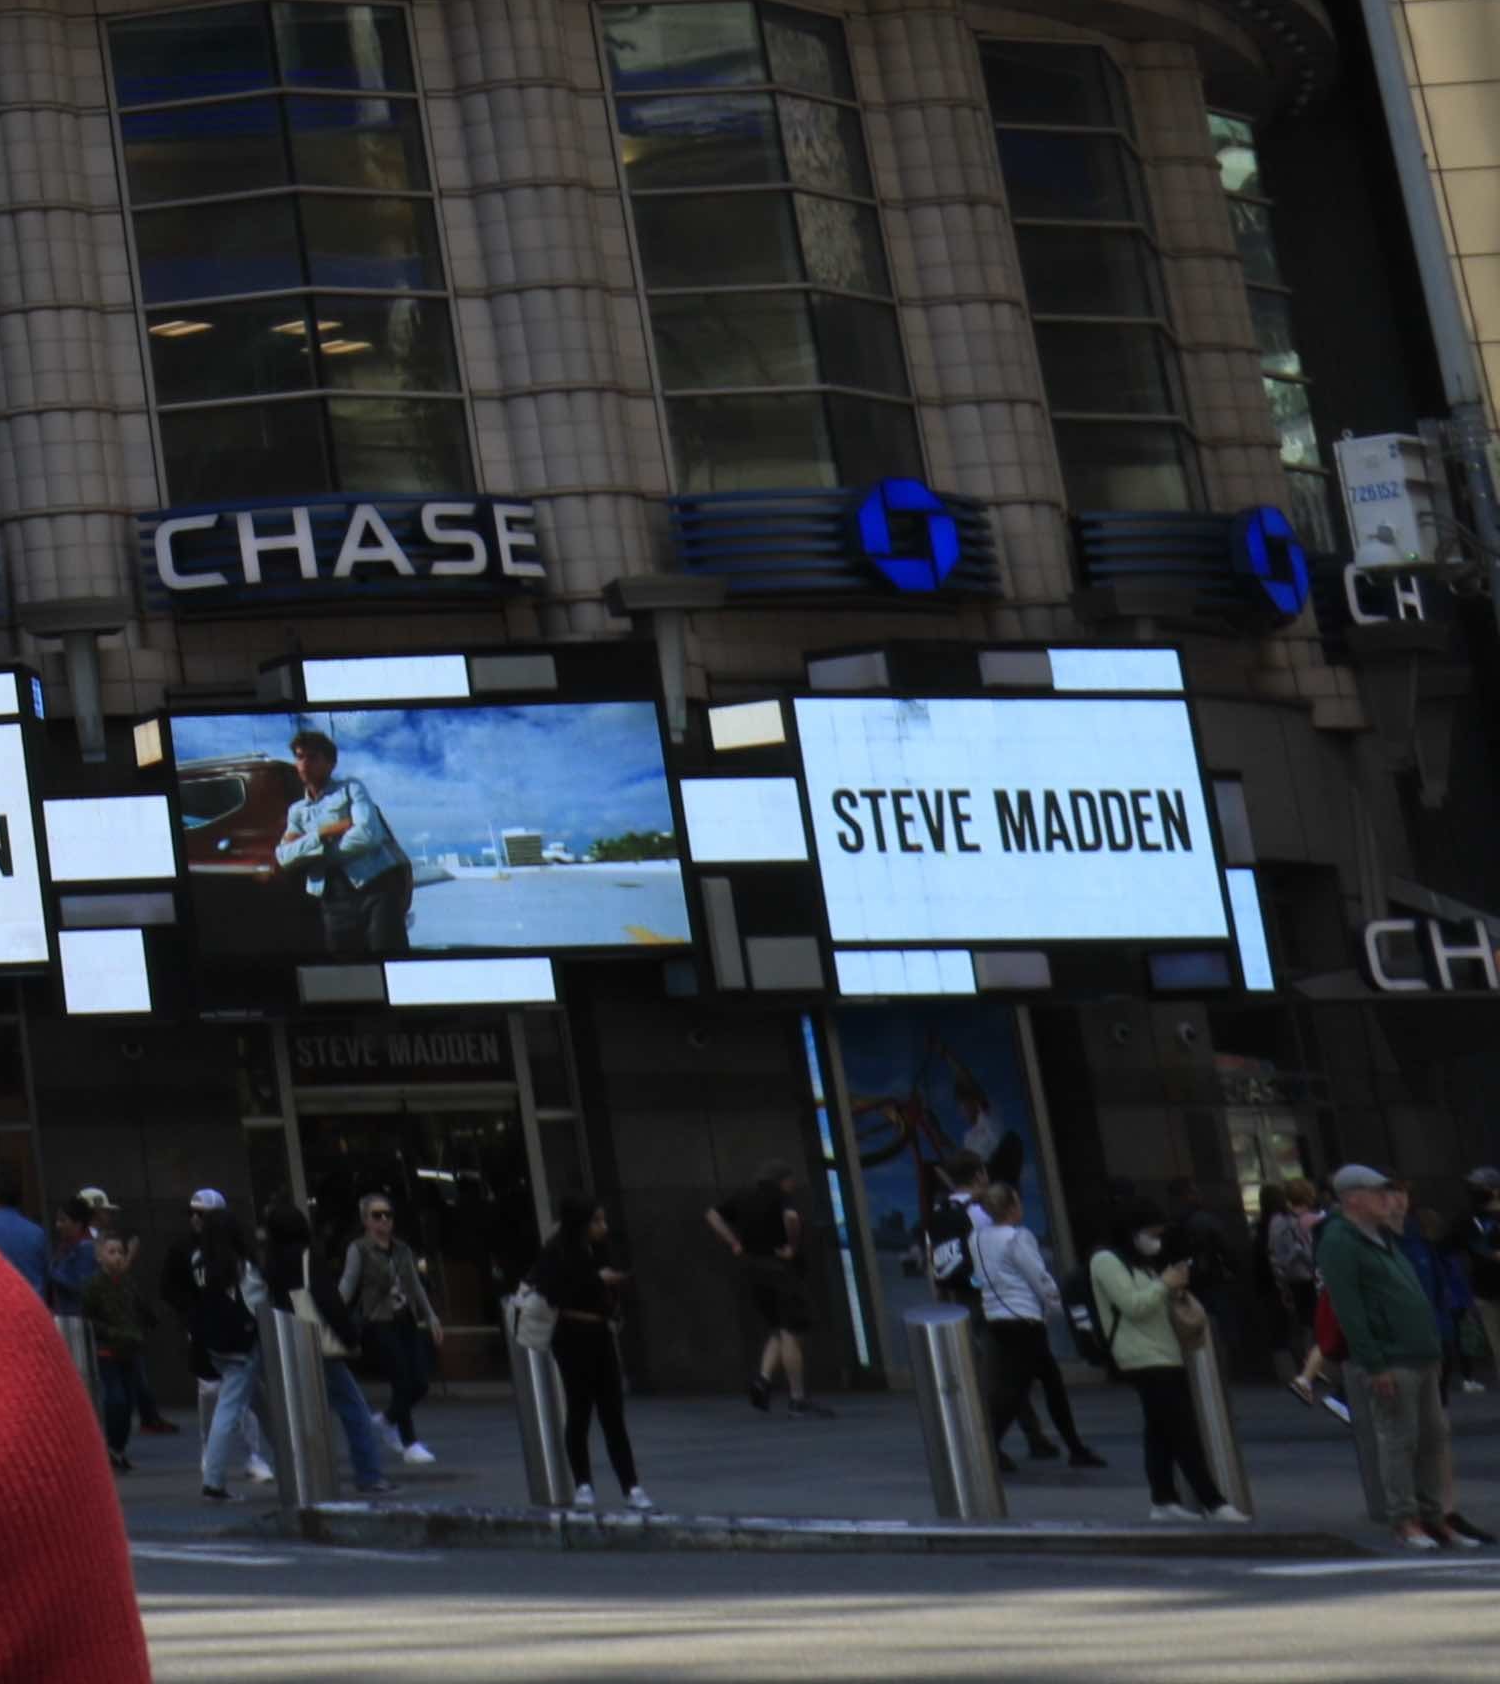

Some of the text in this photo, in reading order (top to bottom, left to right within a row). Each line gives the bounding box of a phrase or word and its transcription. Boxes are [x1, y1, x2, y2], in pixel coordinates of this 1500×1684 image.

[154, 502, 547, 592] CHASE
[831, 788, 1193, 854] STEVE MADDEN
[295, 1030, 500, 1069] STEVE MADDEN
